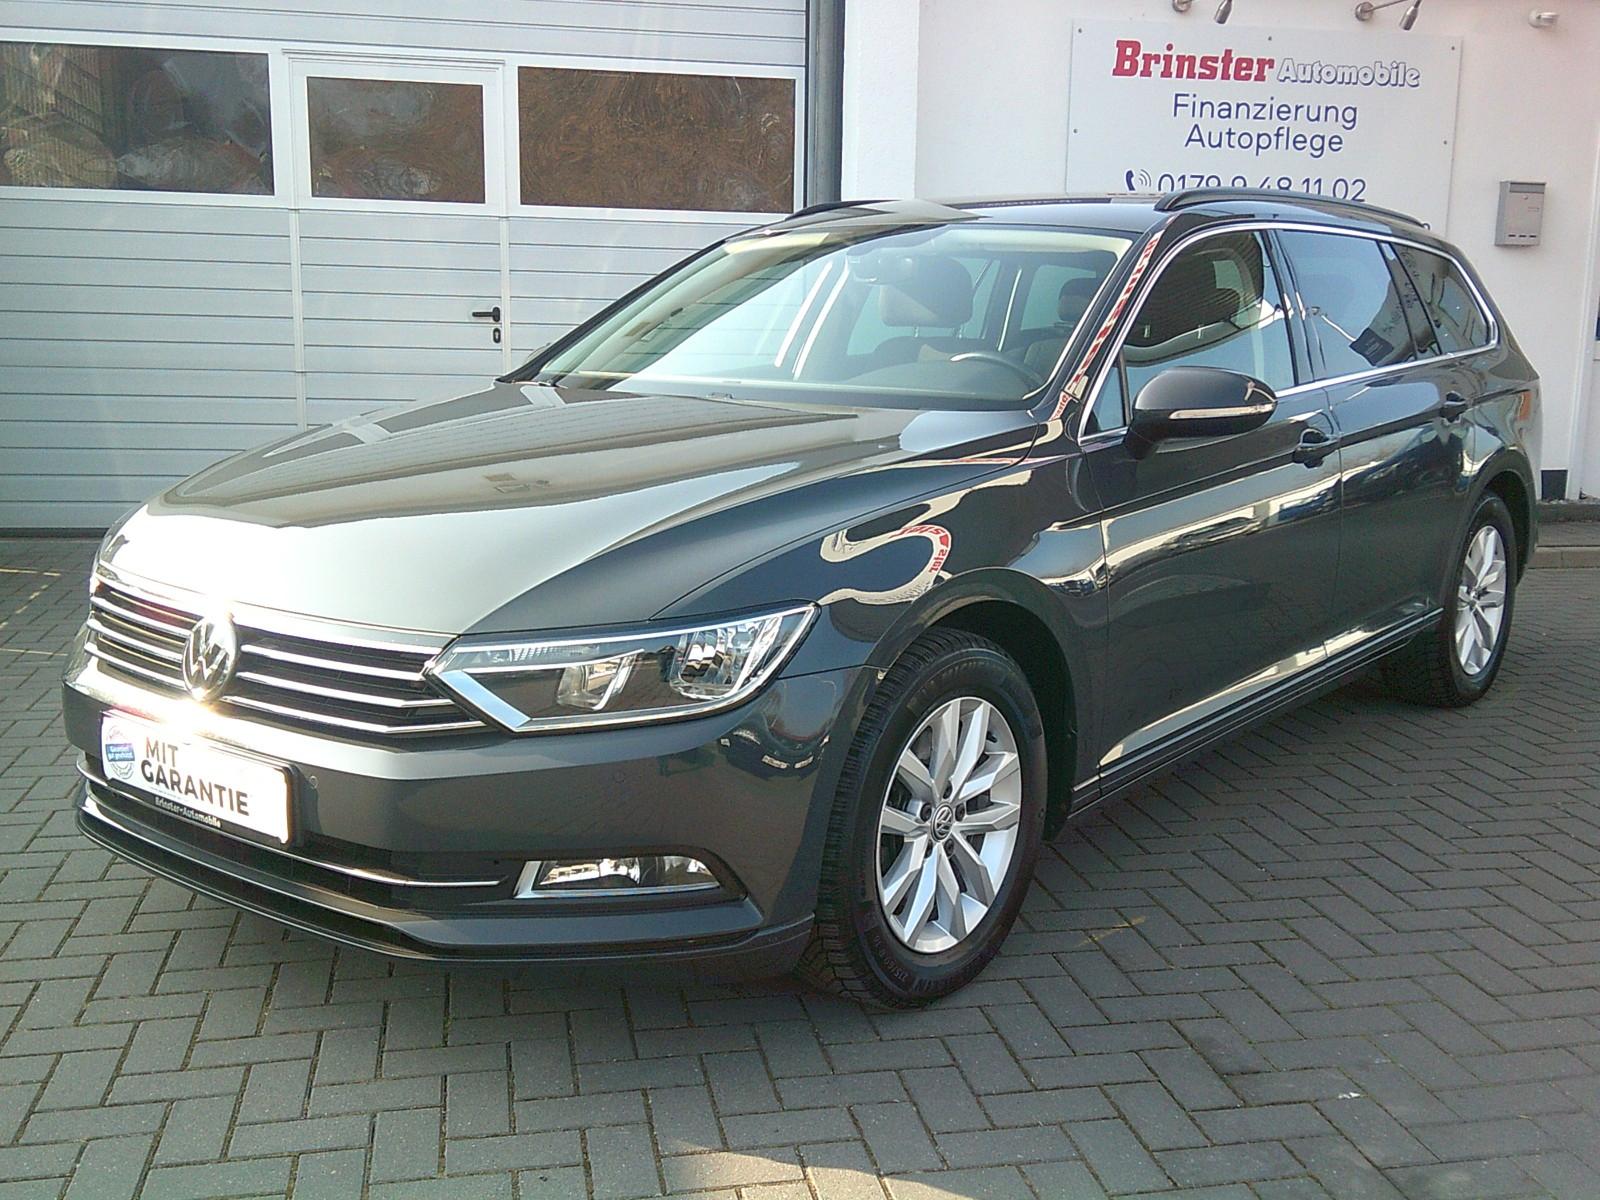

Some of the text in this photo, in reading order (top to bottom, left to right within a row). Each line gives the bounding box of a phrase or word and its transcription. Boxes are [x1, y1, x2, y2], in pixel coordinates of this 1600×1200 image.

[1112, 39, 1422, 87] Brinster Automobile
[1172, 93, 1358, 130] Finanzierung
[1184, 124, 1344, 158] Autopflege
[1301, 177, 1323, 195] 11
[1332, 178, 1366, 203] 02
[145, 736, 179, 768] MIT
[140, 759, 250, 817] GARANTIE
